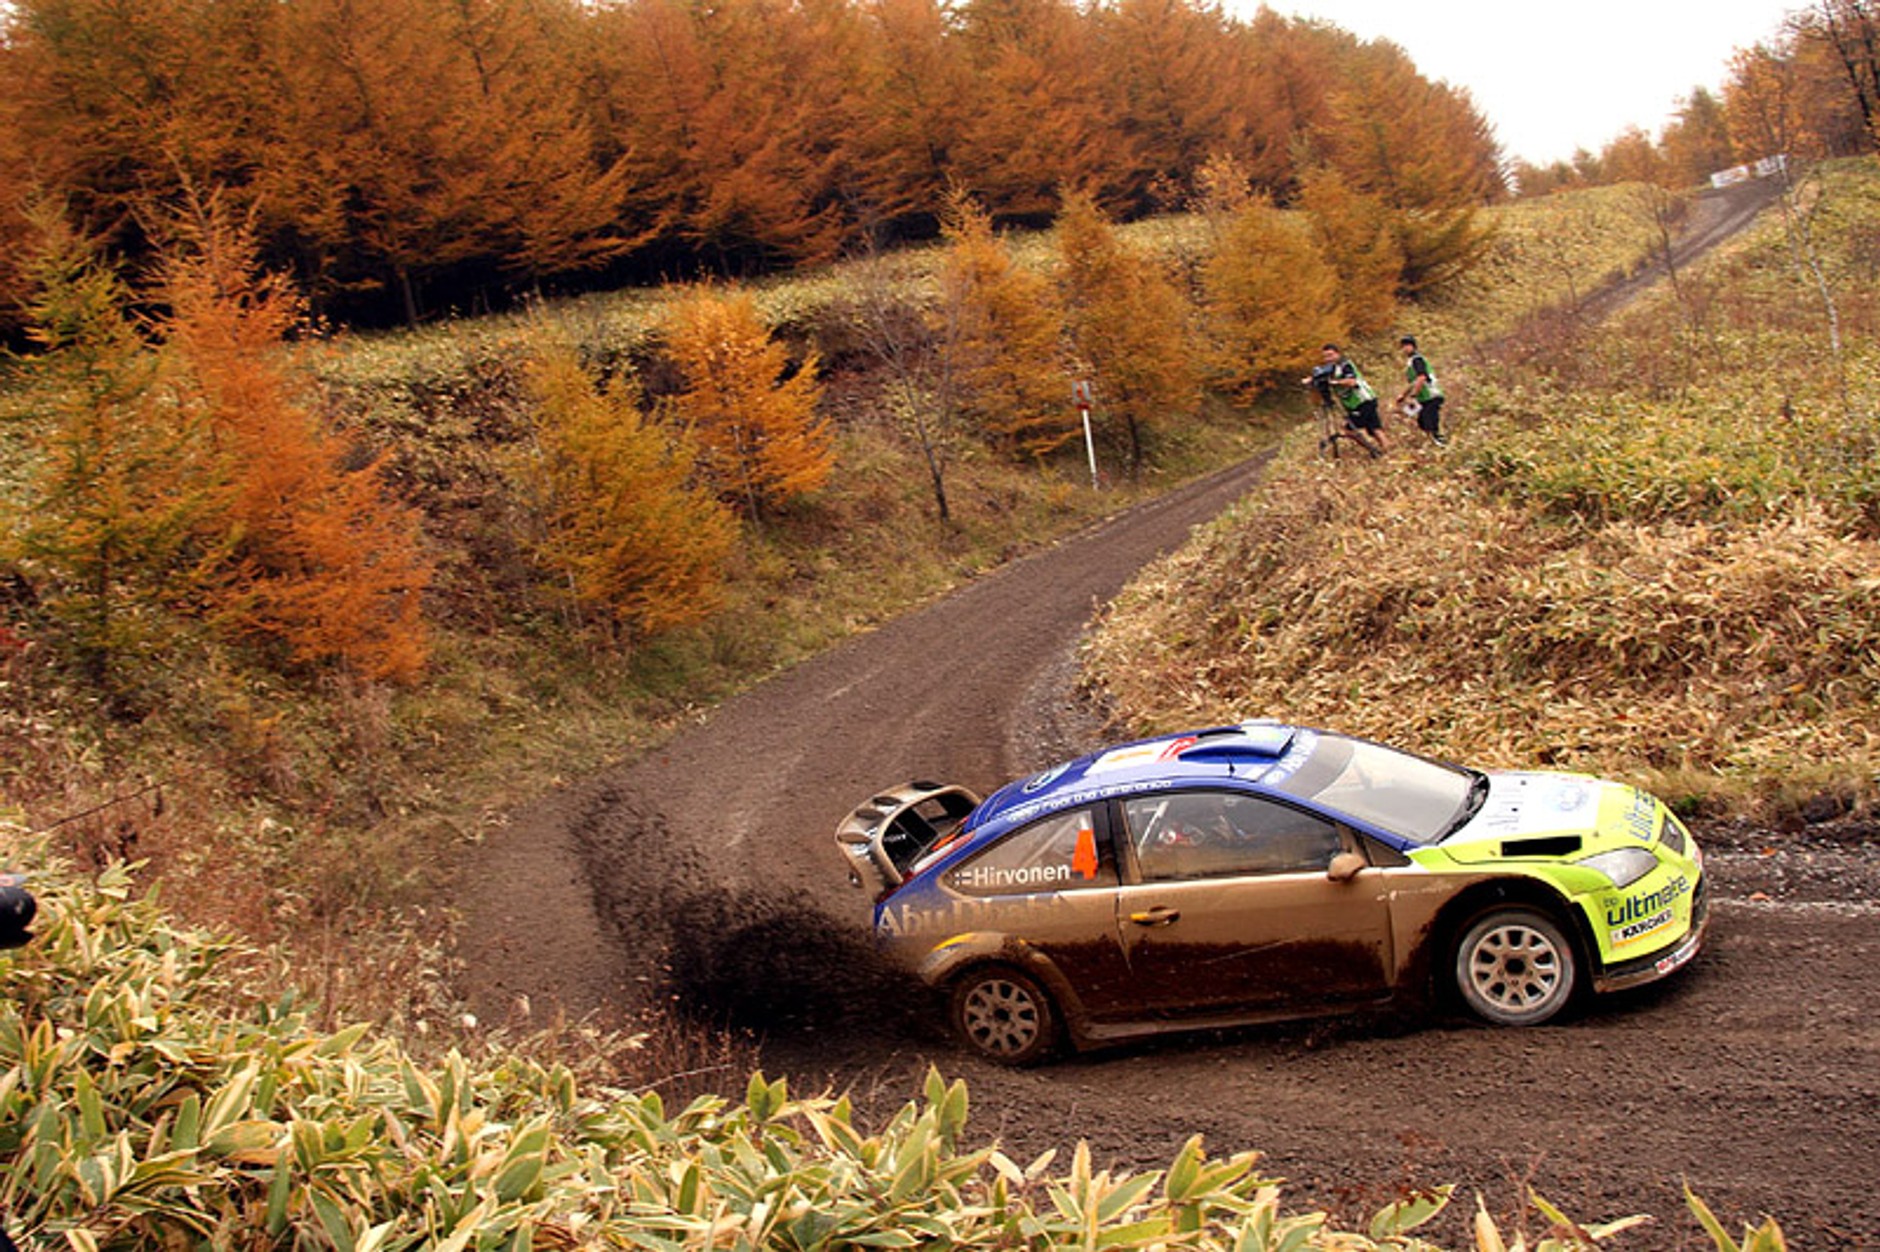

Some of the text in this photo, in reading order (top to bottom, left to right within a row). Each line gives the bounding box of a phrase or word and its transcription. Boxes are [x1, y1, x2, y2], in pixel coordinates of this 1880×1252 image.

[974, 864, 1071, 887] Hirvonen
[1071, 828, 1099, 880] 4
[876, 902, 946, 937] Abu
[1607, 875, 1691, 927] ultimate
